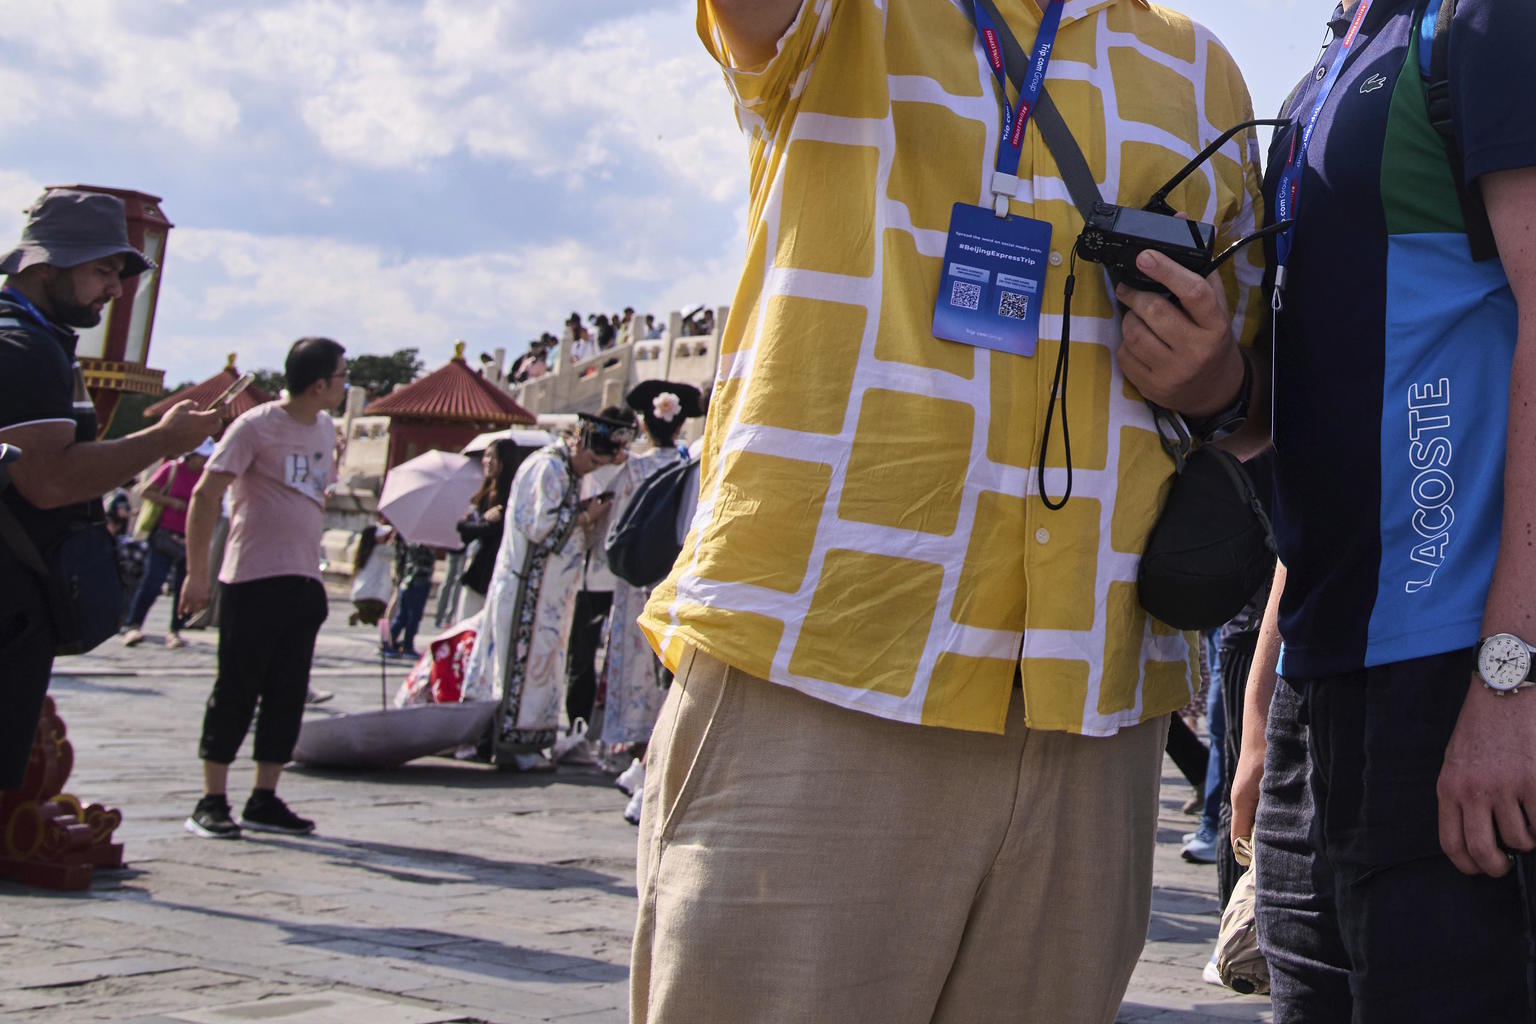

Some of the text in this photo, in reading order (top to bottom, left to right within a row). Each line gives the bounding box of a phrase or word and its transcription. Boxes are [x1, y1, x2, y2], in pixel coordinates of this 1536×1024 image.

[1029, 43, 1051, 92] Trip.com Group
[959, 243, 1036, 265] #BeijingExpressTrip
[1405, 378, 1455, 593] LACOSTE
